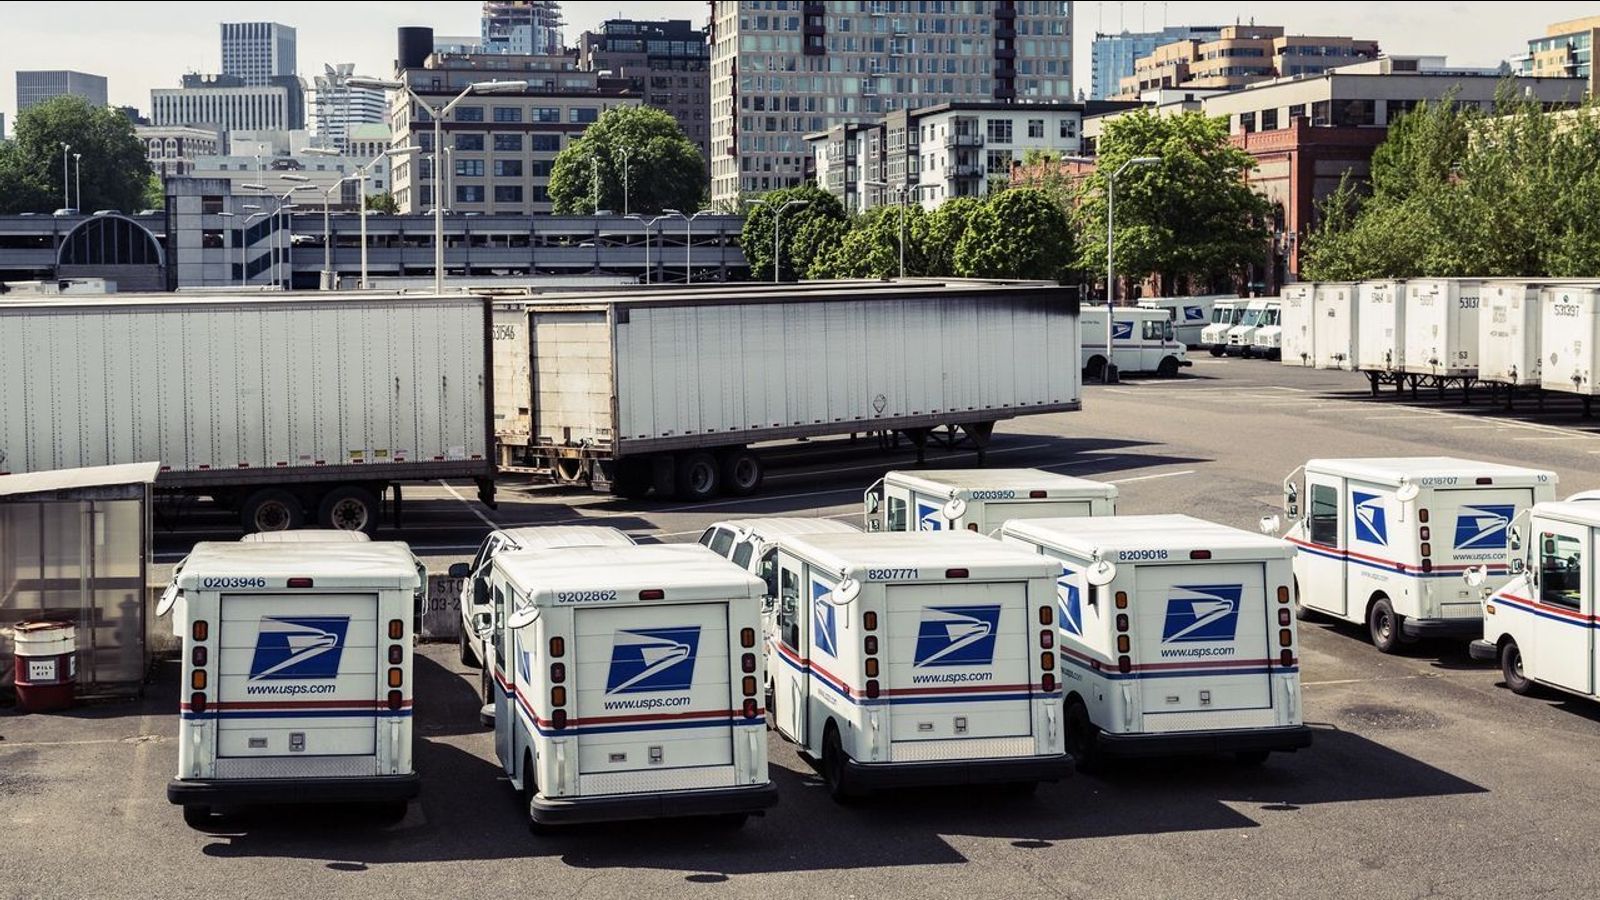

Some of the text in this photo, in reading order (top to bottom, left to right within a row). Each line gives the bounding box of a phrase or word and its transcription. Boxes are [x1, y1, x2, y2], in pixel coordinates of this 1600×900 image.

[1554, 304, 1580, 317] 531397
[1422, 476, 1458, 486] 0218707
[972, 490, 1015, 500] 0203950
[1119, 549, 1168, 561] 8209018
[868, 568, 919, 580] 8207771
[203, 576, 266, 589] 0203946
[557, 589, 617, 604] 9202862
[427, 597, 461, 612] 03-2
[1161, 646, 1236, 659] www.usps.com
[913, 671, 993, 685] www.usps.com
[247, 683, 336, 697] www.usps.com
[604, 695, 691, 711] www.usps.com
